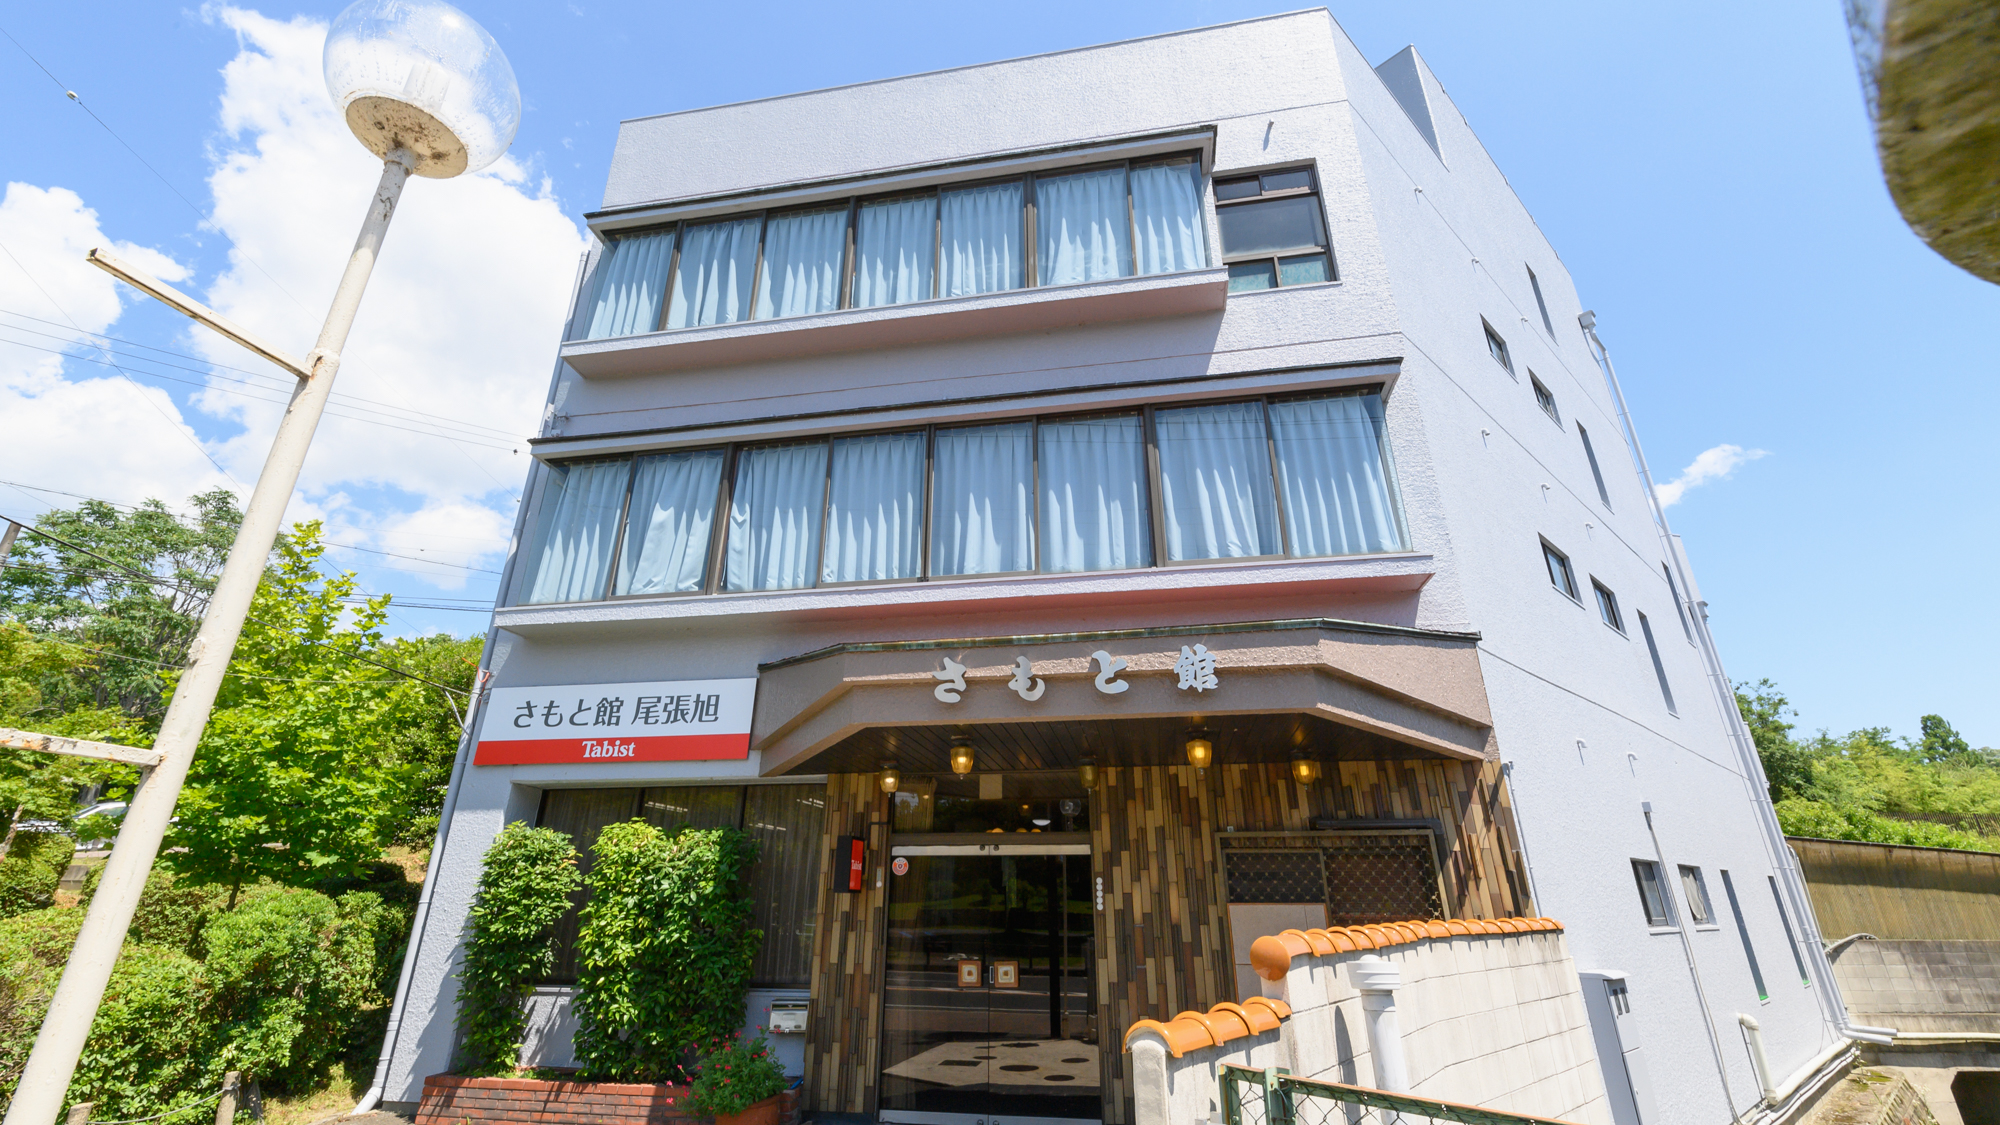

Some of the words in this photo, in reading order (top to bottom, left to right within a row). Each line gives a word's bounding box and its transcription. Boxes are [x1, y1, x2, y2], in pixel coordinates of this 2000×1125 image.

[932, 643, 1219, 703] さもと館
[513, 696, 625, 728] さもと館
[630, 693, 721, 725] 尾張旭
[581, 740, 636, 758] Tabist
